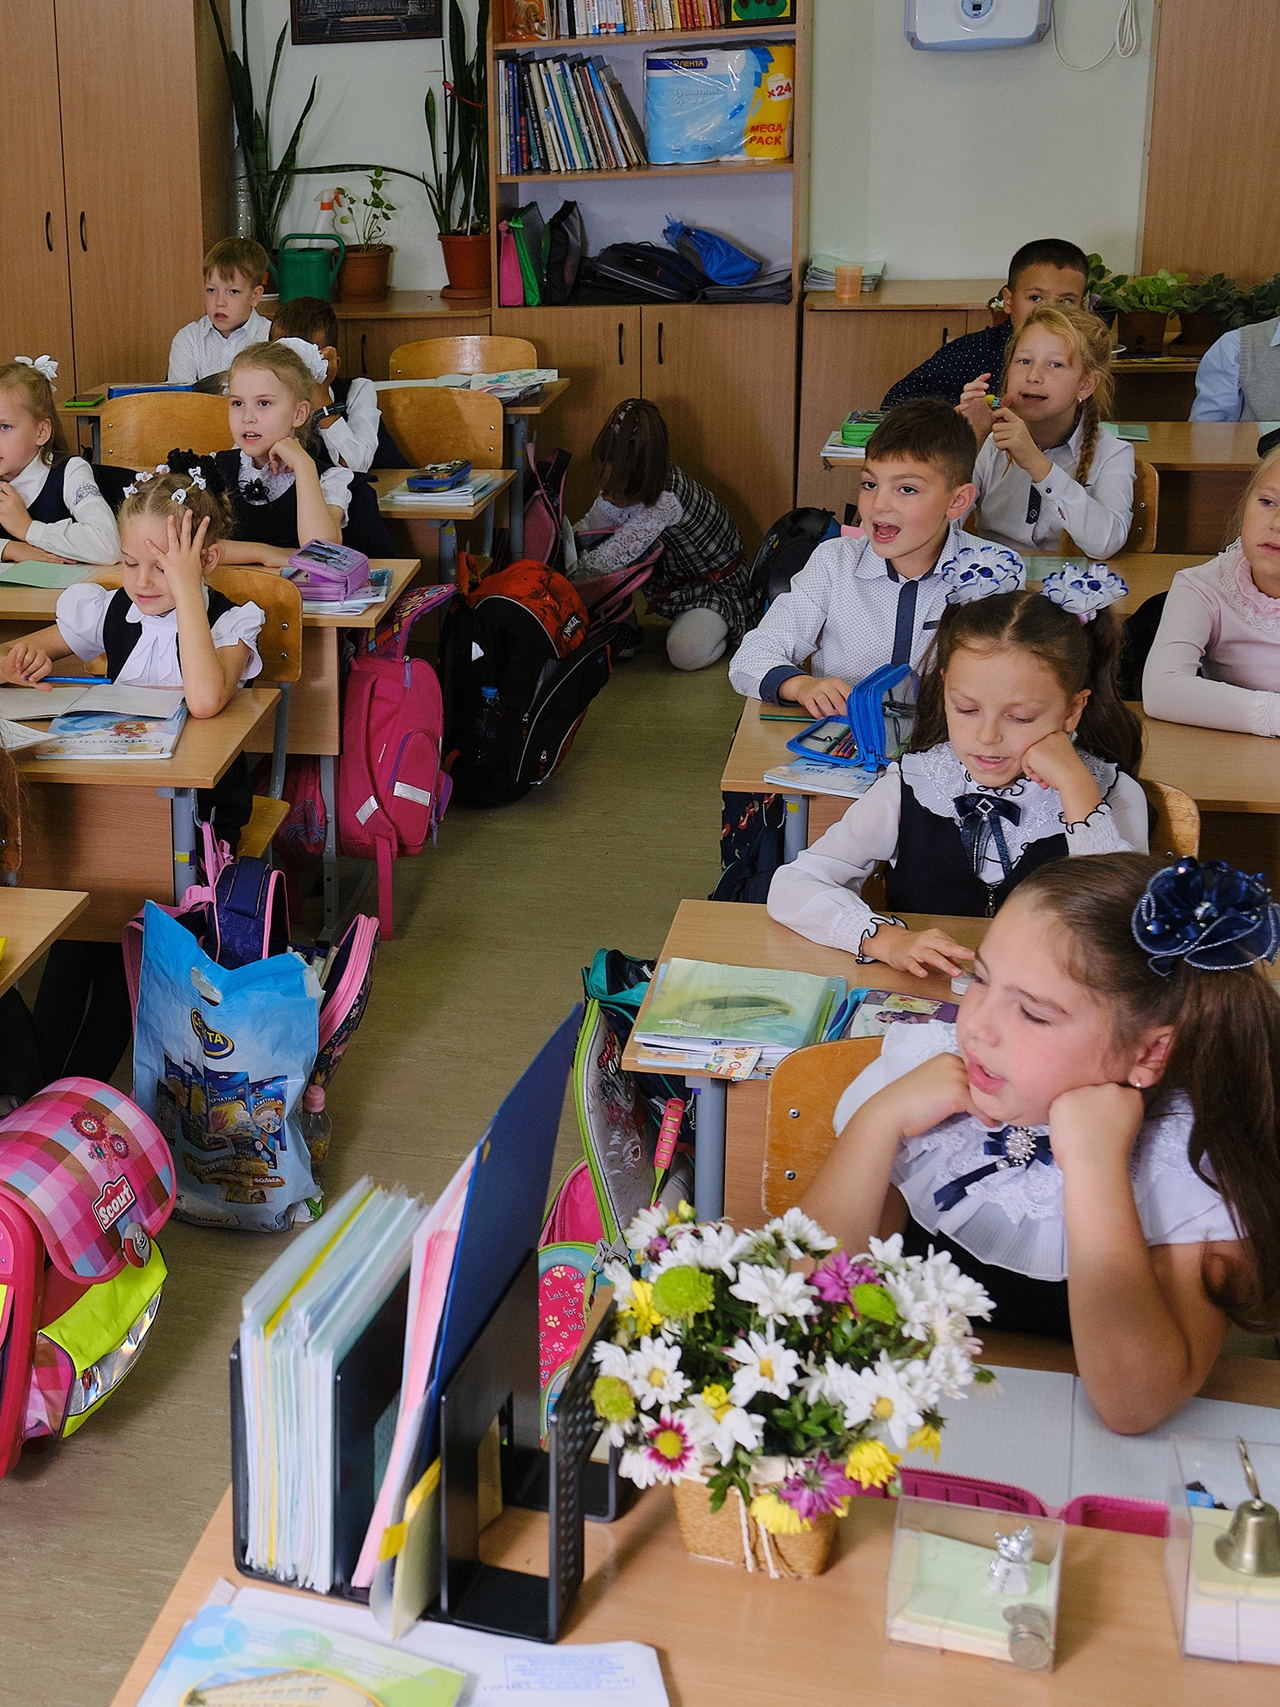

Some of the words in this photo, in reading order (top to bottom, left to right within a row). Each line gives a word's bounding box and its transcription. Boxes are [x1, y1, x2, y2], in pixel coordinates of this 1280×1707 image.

[750, 123, 783, 133] MEGA
[749, 135, 782, 146] PACK
[99, 1184, 131, 1225] Scout
[546, 1289, 570, 1301] Let's
[568, 1297, 579, 1306] go
[563, 1306, 577, 1318] for
[567, 1320, 585, 1331] Wal
